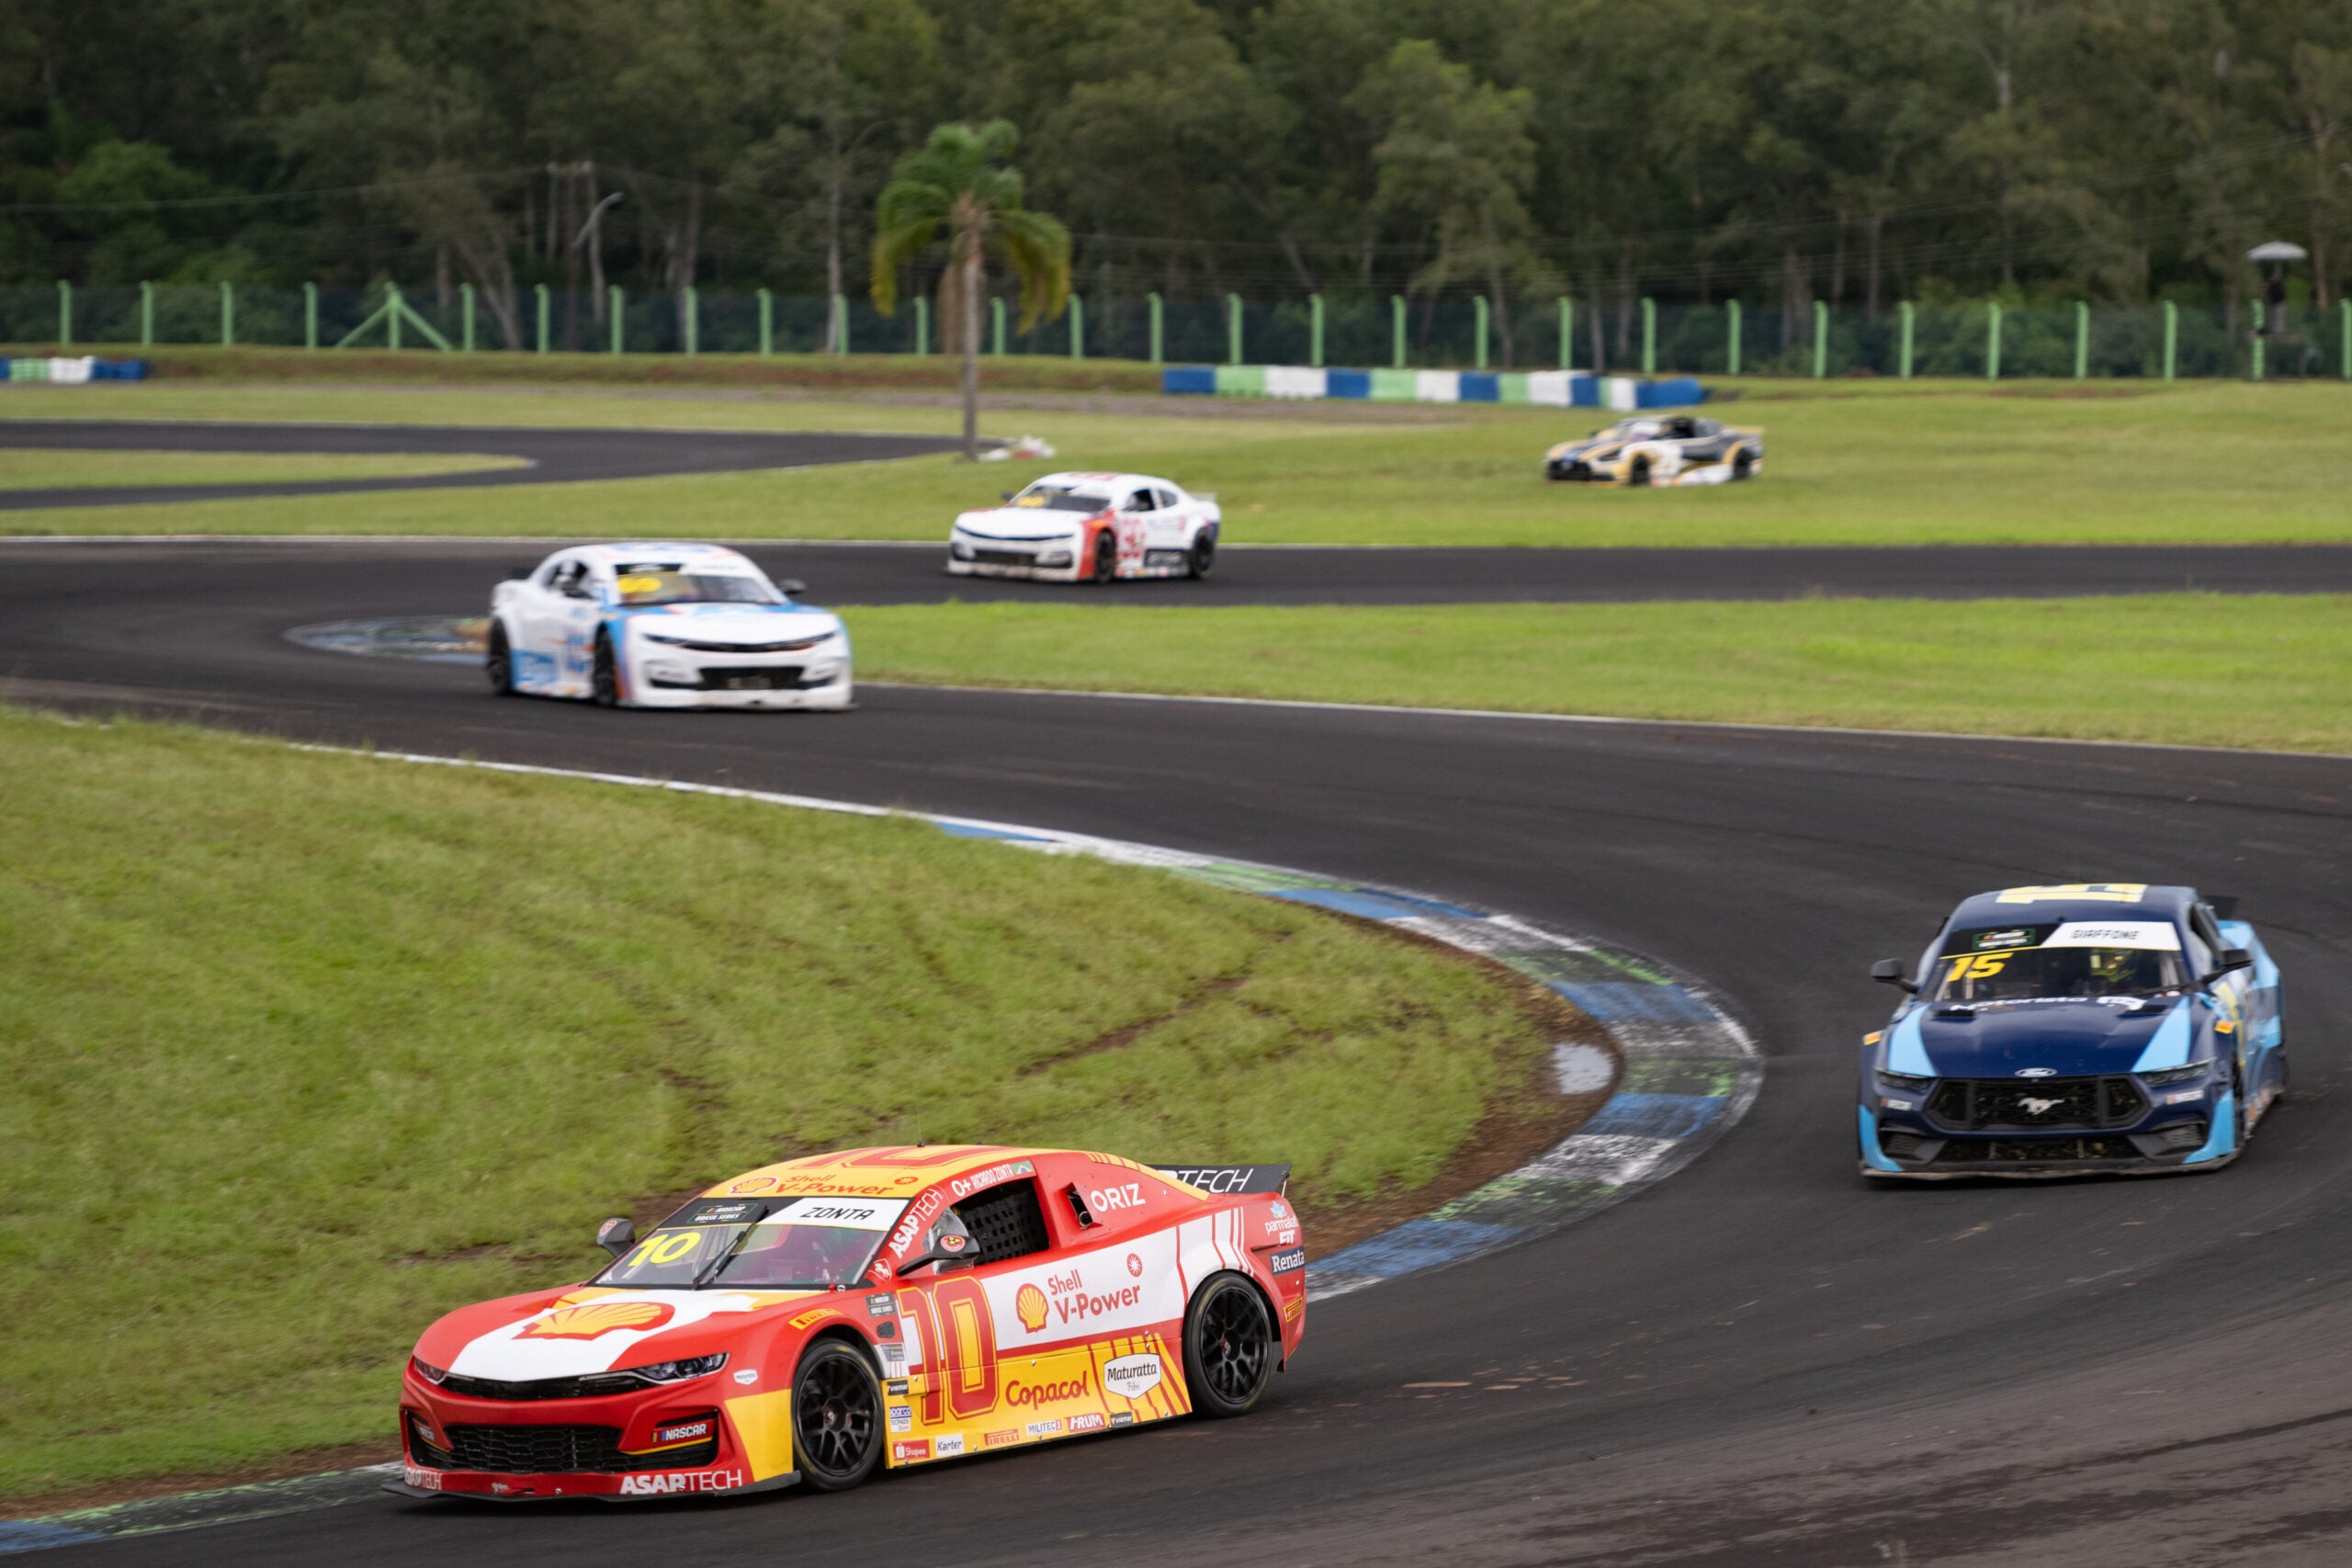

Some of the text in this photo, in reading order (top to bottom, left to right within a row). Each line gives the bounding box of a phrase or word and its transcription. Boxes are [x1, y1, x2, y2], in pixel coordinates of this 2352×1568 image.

[1947, 952, 2014, 982] 15
[775, 1182, 894, 1195] V-Power
[786, 1174, 836, 1183] Shell
[1091, 1182, 1146, 1213] ORIZ
[799, 1207, 876, 1221] ZONTA
[888, 1188, 944, 1259] ASAPTECH
[628, 1232, 702, 1267] 10
[1047, 1269, 1083, 1296] Shell
[1054, 1284, 1141, 1325] V-Power
[896, 1276, 1000, 1426] 10
[1107, 1362, 1158, 1382] Maturatta
[1006, 1370, 1091, 1411] Copacol
[665, 1423, 707, 1440] NASCAR
[984, 1428, 1020, 1446] PIRELLI
[1028, 1421, 1056, 1434] MILITEC
[905, 1446, 926, 1457] Shopee
[937, 1440, 962, 1451] Karter
[620, 1469, 742, 1495] ASAPTECH
